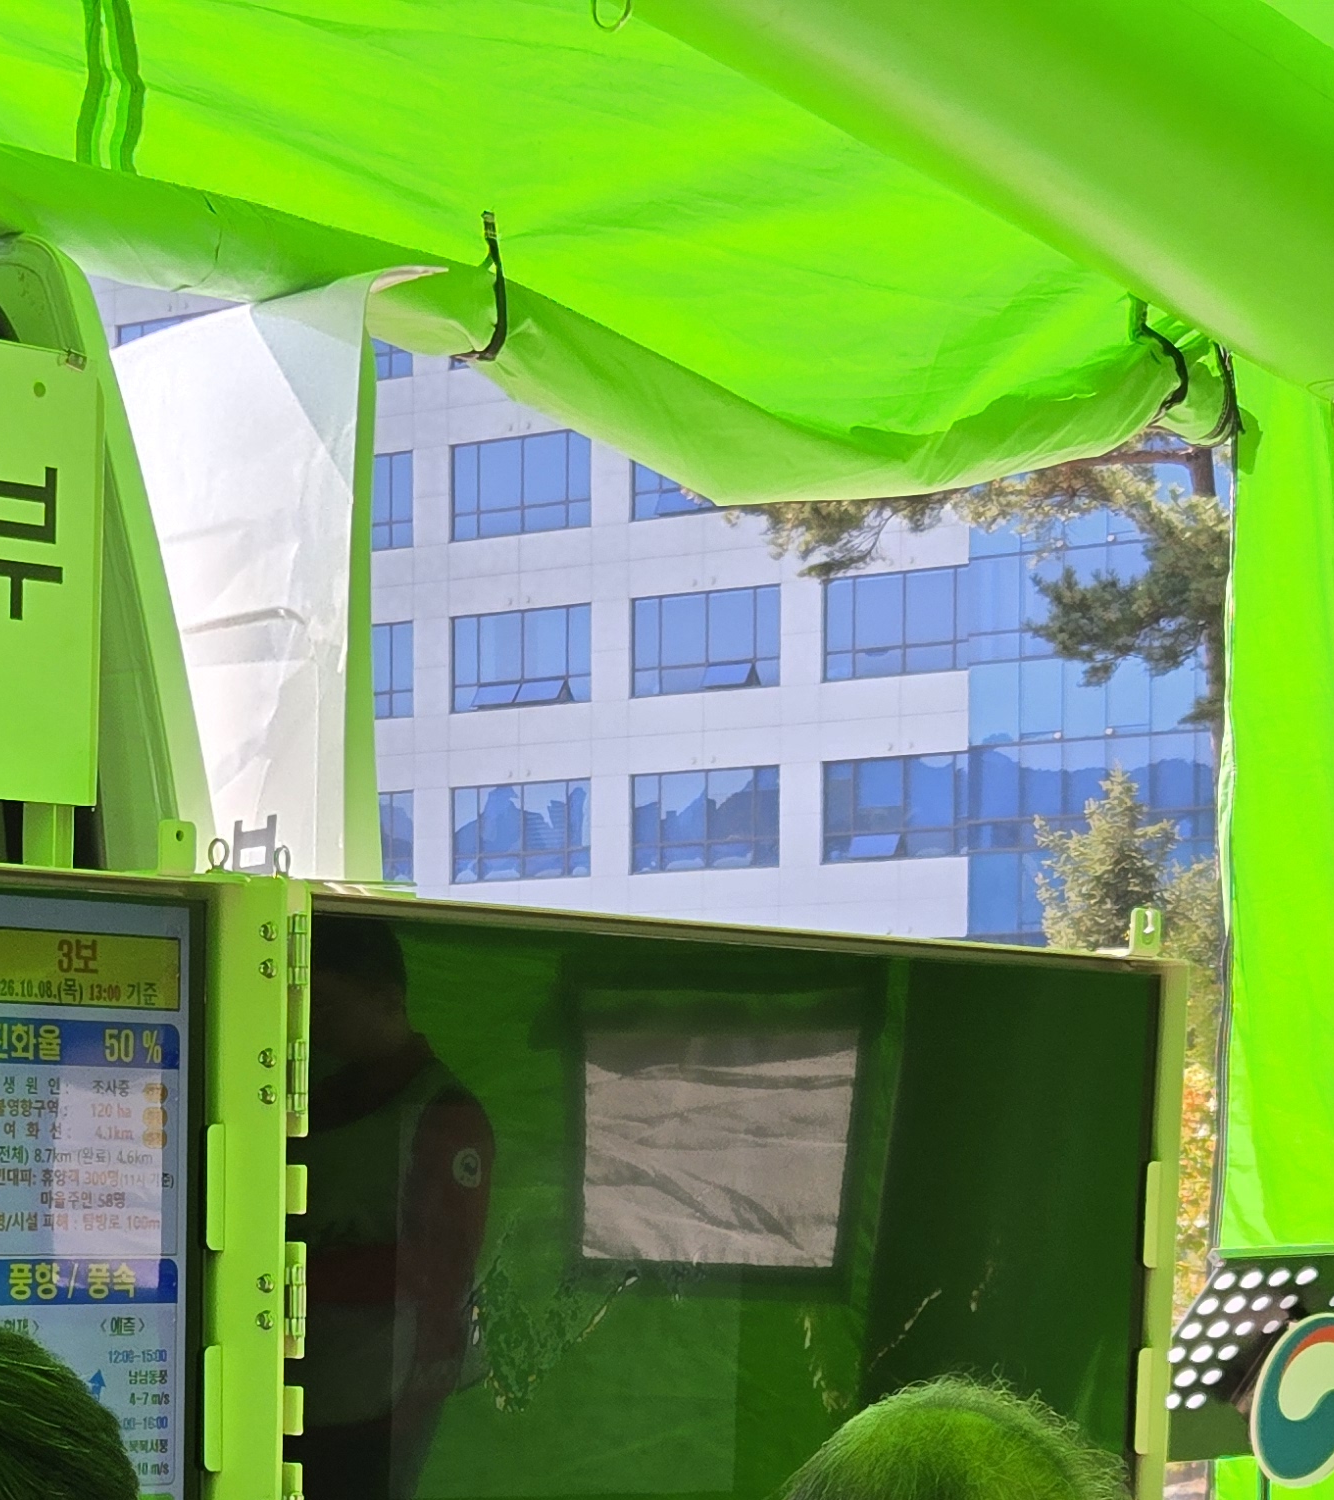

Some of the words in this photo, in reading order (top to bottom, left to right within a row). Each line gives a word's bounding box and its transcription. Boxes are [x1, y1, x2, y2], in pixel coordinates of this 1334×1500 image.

[57, 938, 99, 974] 3보
[127, 982, 157, 1005] 기준
[105, 1029, 134, 1062] 50
[142, 1029, 162, 1063] %
[92, 1080, 130, 1097] 조사중
[34, 1150, 71, 1164] 8.7km
[41, 1169, 80, 1186] 휴양객
[41, 1192, 93, 1209] 마을주민
[98, 1192, 126, 1209] 58명
[9, 1262, 60, 1300] 풍향
[88, 1262, 136, 1299] 풍속
